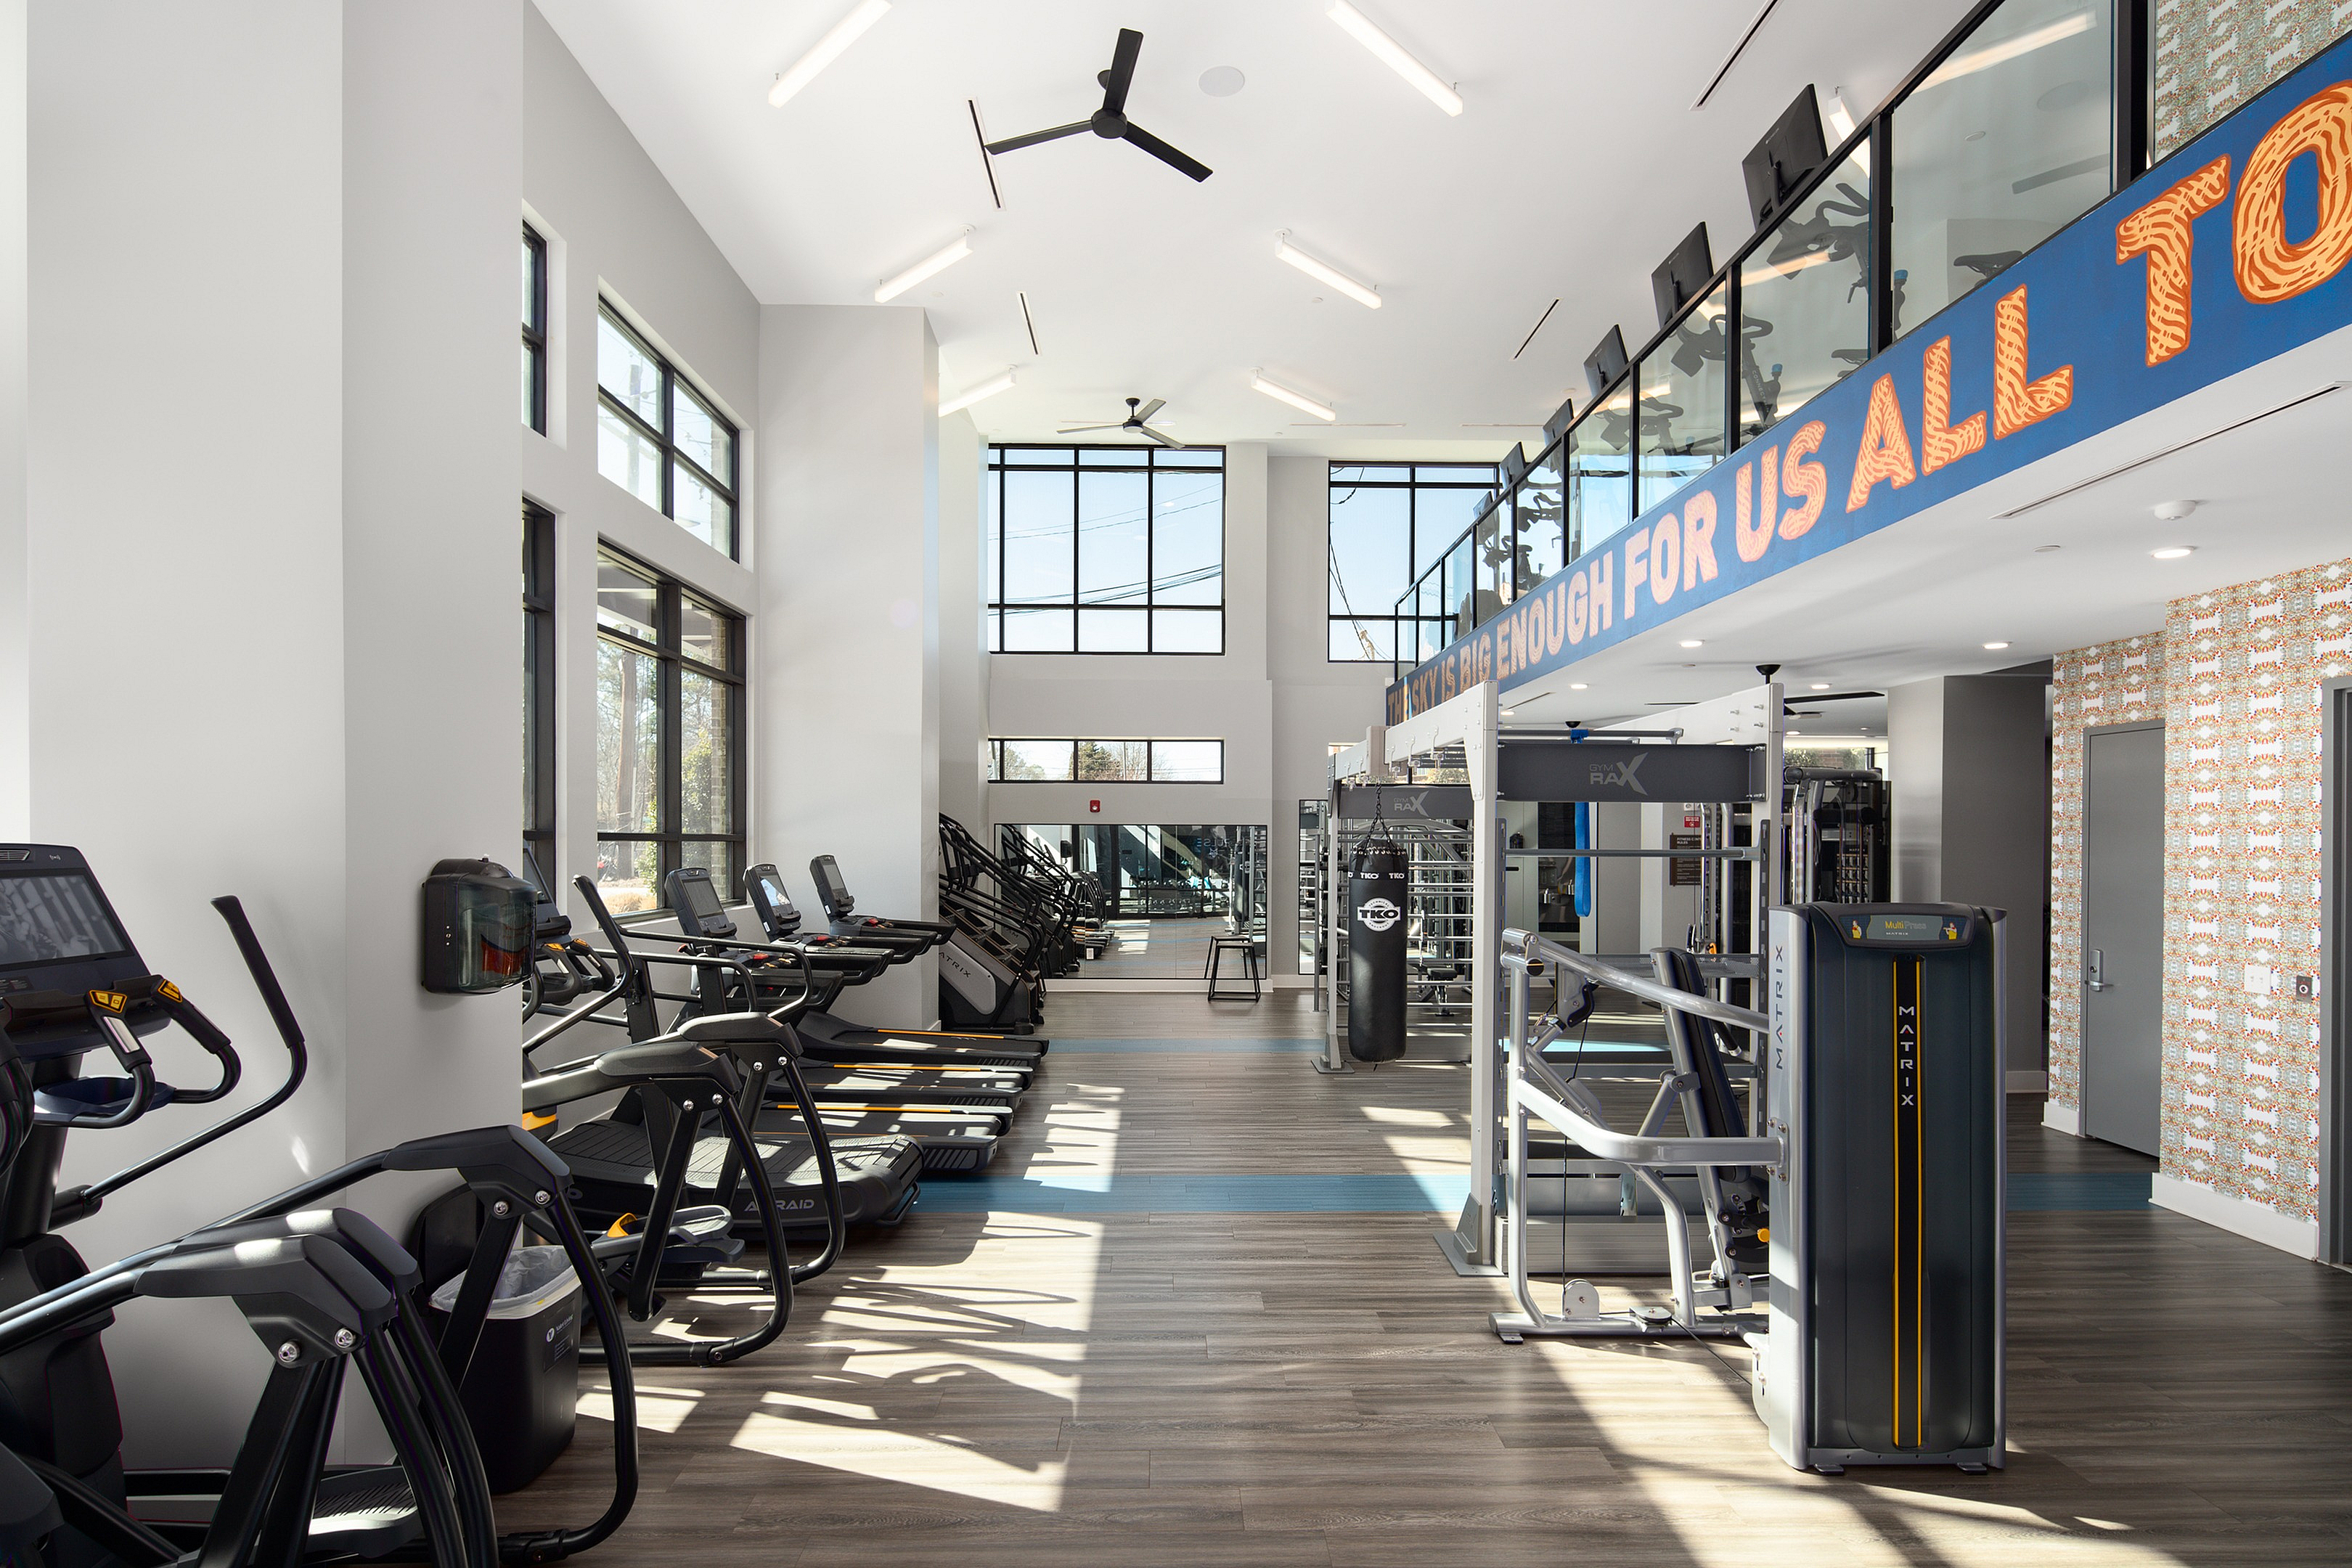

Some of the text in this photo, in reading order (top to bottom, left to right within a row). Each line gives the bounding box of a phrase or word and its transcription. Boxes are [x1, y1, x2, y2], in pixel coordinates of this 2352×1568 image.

[1388, 79, 2352, 727] THE SKY IS BIG ENOUGH FOR US ALL TO
[1591, 752, 1649, 796] RAX
[1395, 790, 1429, 817] RAX
[1359, 910, 1399, 918] TKO
[939, 952, 971, 978] ATRIX
[1899, 1006, 1914, 1106] MATRIX
[744, 1199, 814, 1212] ARAID
